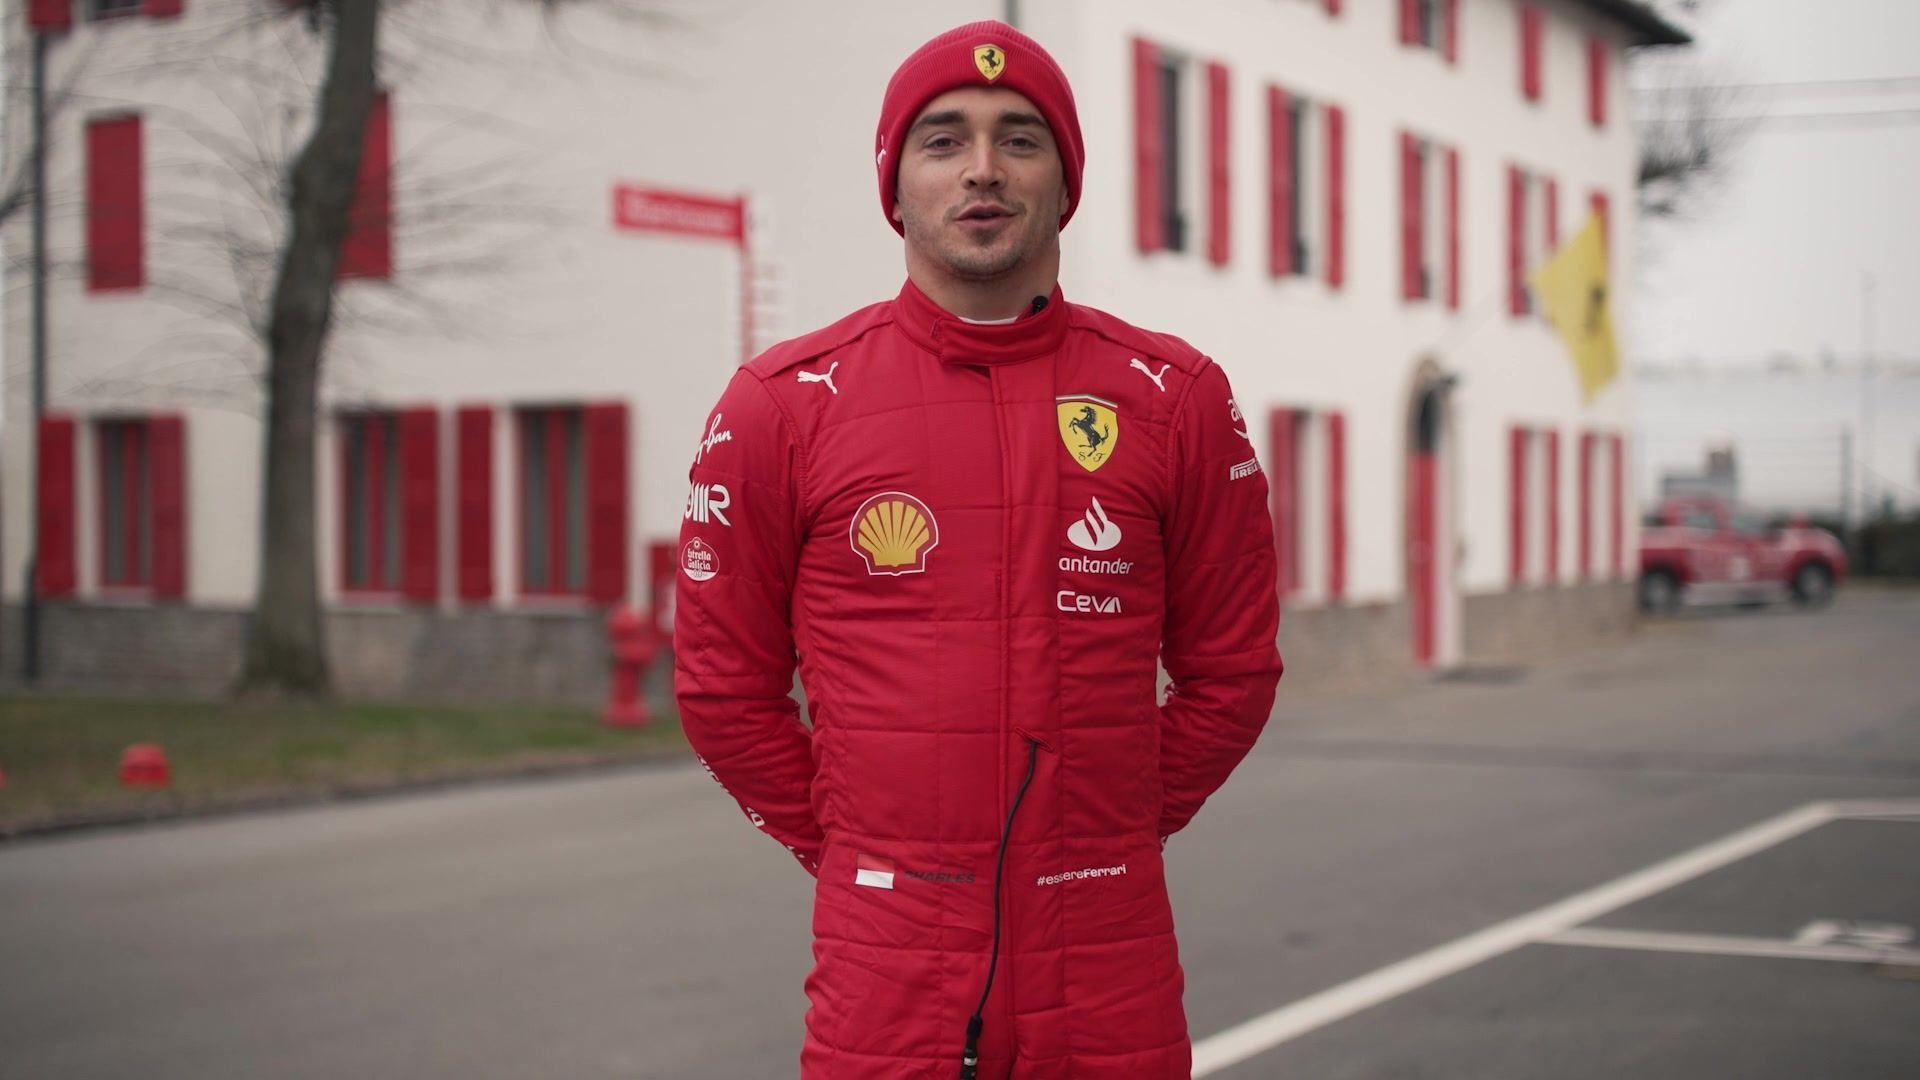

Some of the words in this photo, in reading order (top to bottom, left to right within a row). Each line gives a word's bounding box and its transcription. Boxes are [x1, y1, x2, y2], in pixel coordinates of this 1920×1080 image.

[1230, 457, 1262, 481] PIREL
[687, 548, 712, 561] Estrella
[687, 558, 711, 571] Galicia
[1058, 555, 1134, 575] antander
[1037, 863, 1127, 887] #essereFerrari
